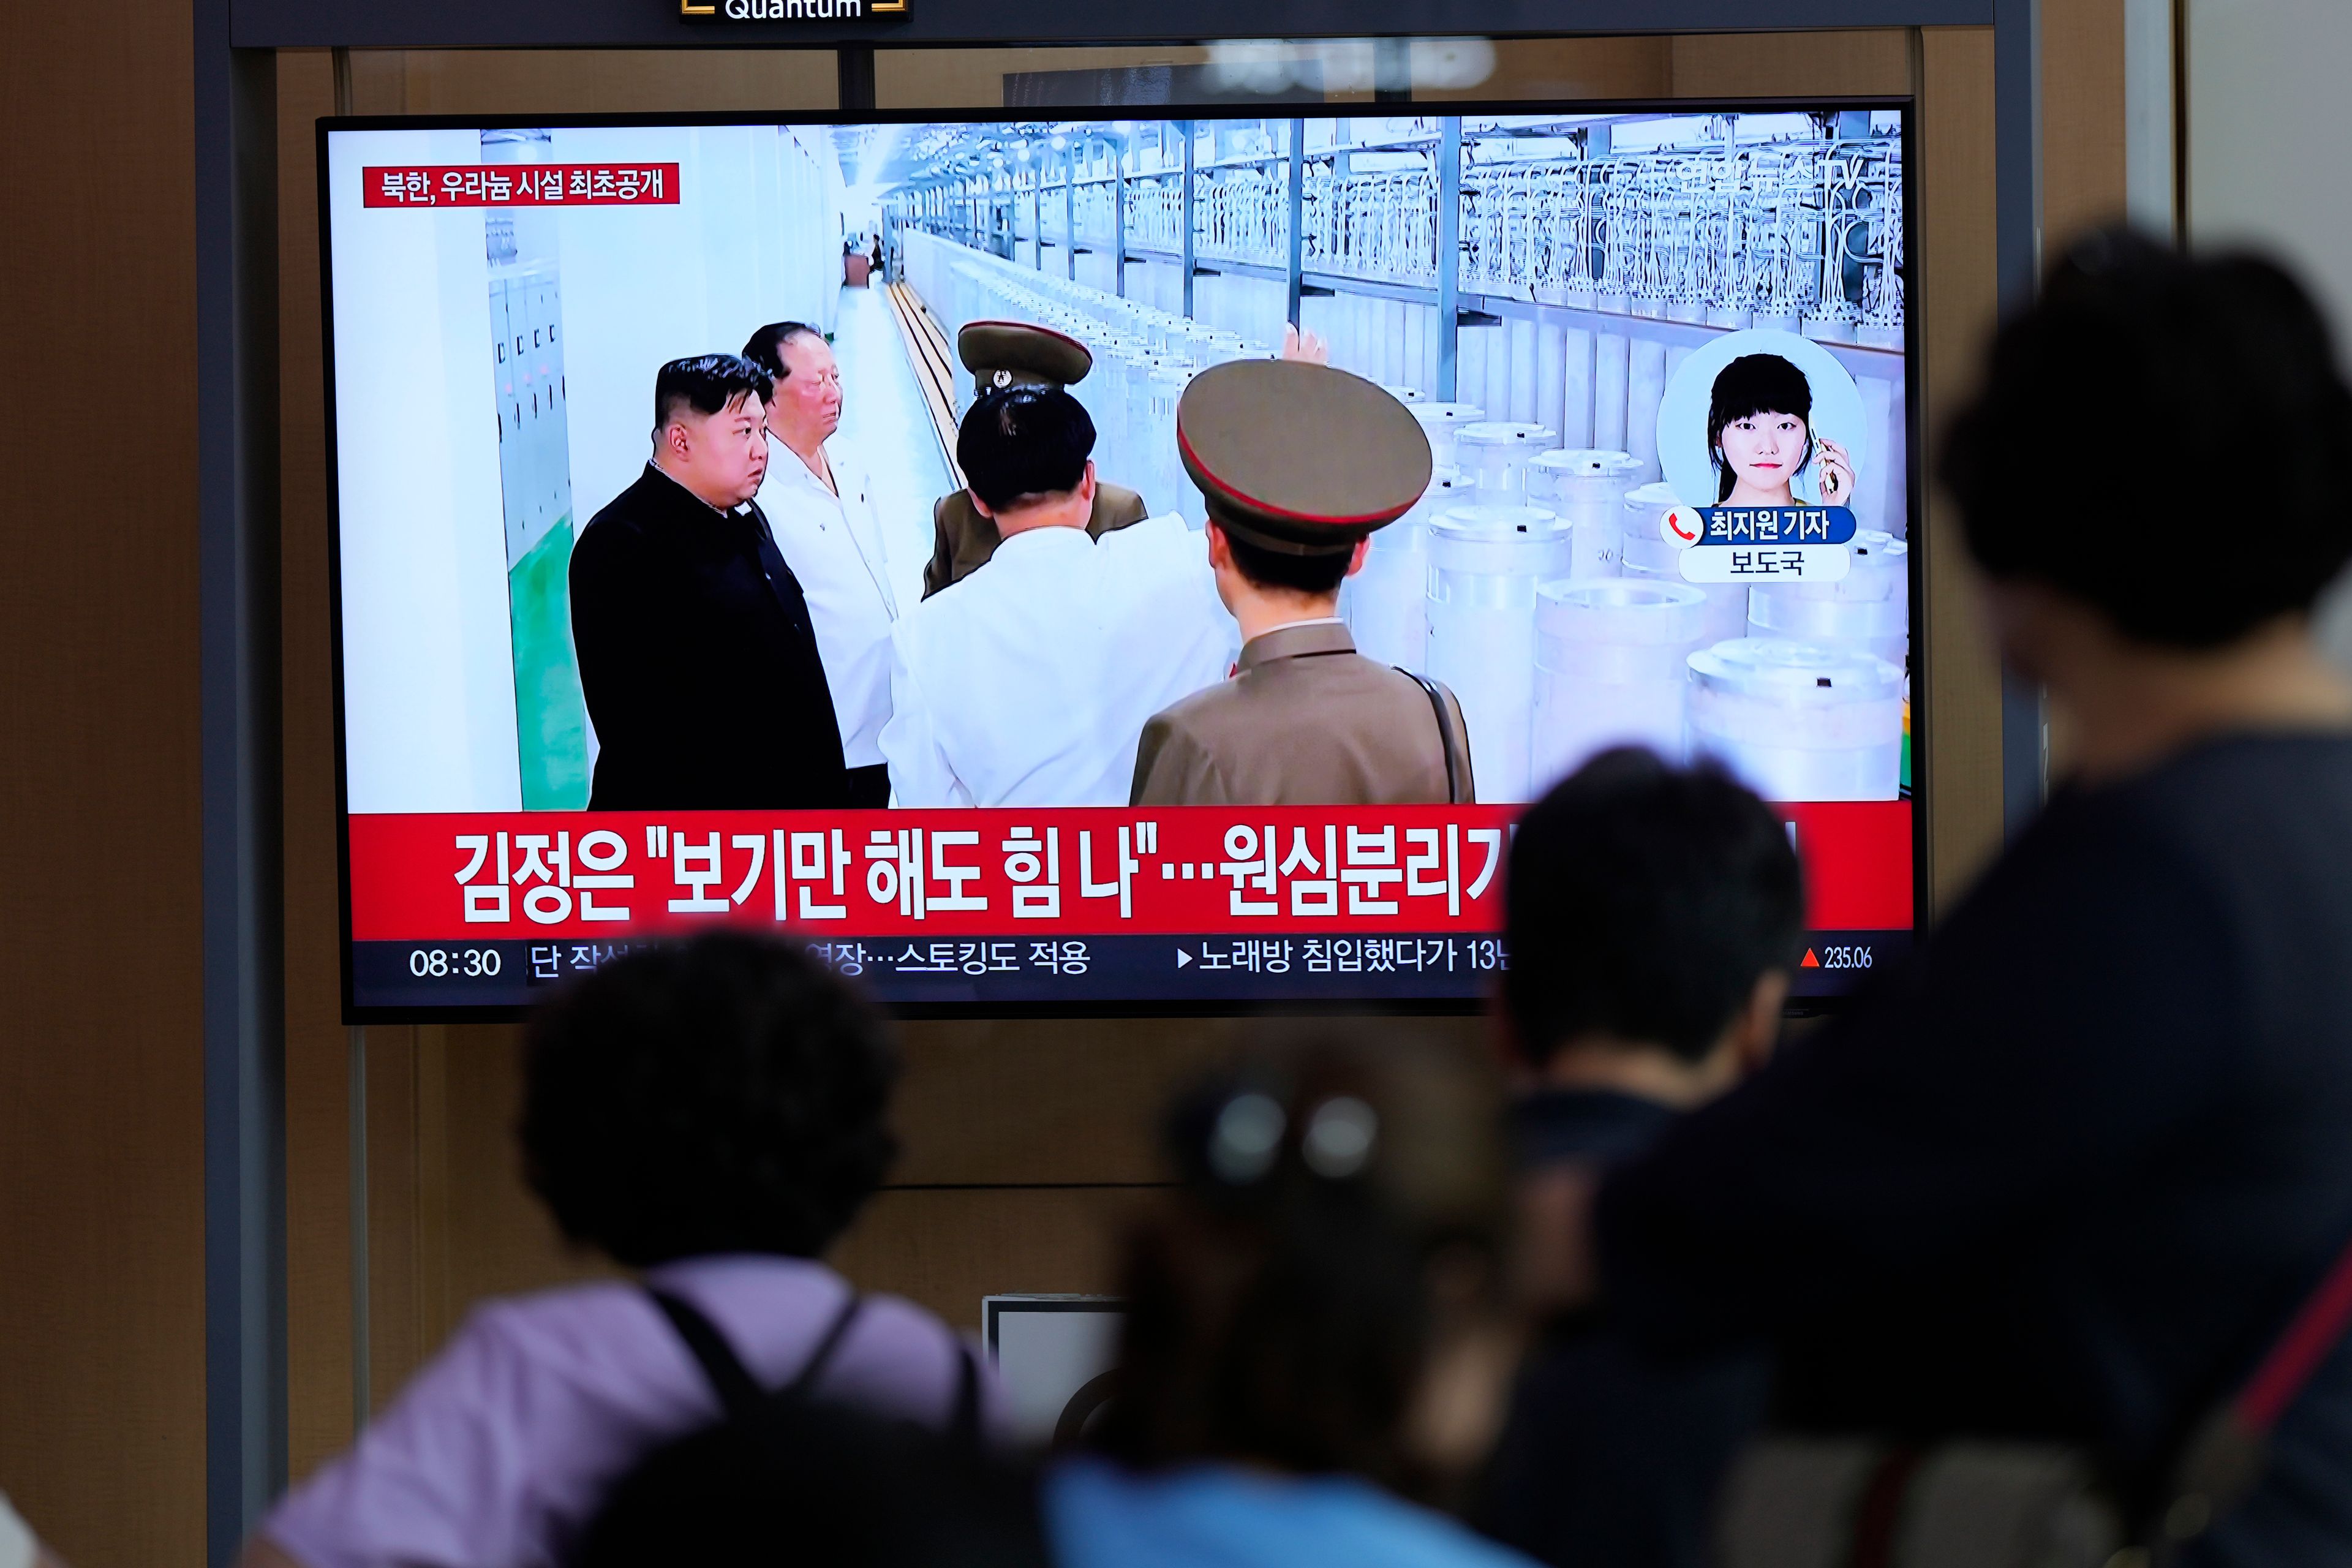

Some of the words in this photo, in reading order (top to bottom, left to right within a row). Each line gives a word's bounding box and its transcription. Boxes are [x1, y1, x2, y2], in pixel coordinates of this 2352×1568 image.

[725, 0, 861, 19] Quantum
[382, 171, 435, 205] 북한,
[440, 171, 513, 202] 우라늄
[516, 170, 564, 201] 시설
[569, 168, 664, 200] 최초공개
[1710, 510, 1778, 541] 최지원
[1784, 509, 1830, 540] 기자
[1730, 551, 1804, 576] 보도국
[454, 830, 635, 924] 김정은
[646, 826, 851, 921] "보기만
[864, 828, 988, 920] 해도
[1001, 826, 1060, 918] 힘
[410, 949, 501, 977] 08:30
[531, 945, 562, 978] 단
[1028, 941, 1091, 974] 적용
[1199, 940, 1294, 973] 노래방
[1302, 938, 1458, 972] 침입했다가
[1824, 946, 1872, 968] 235.06
